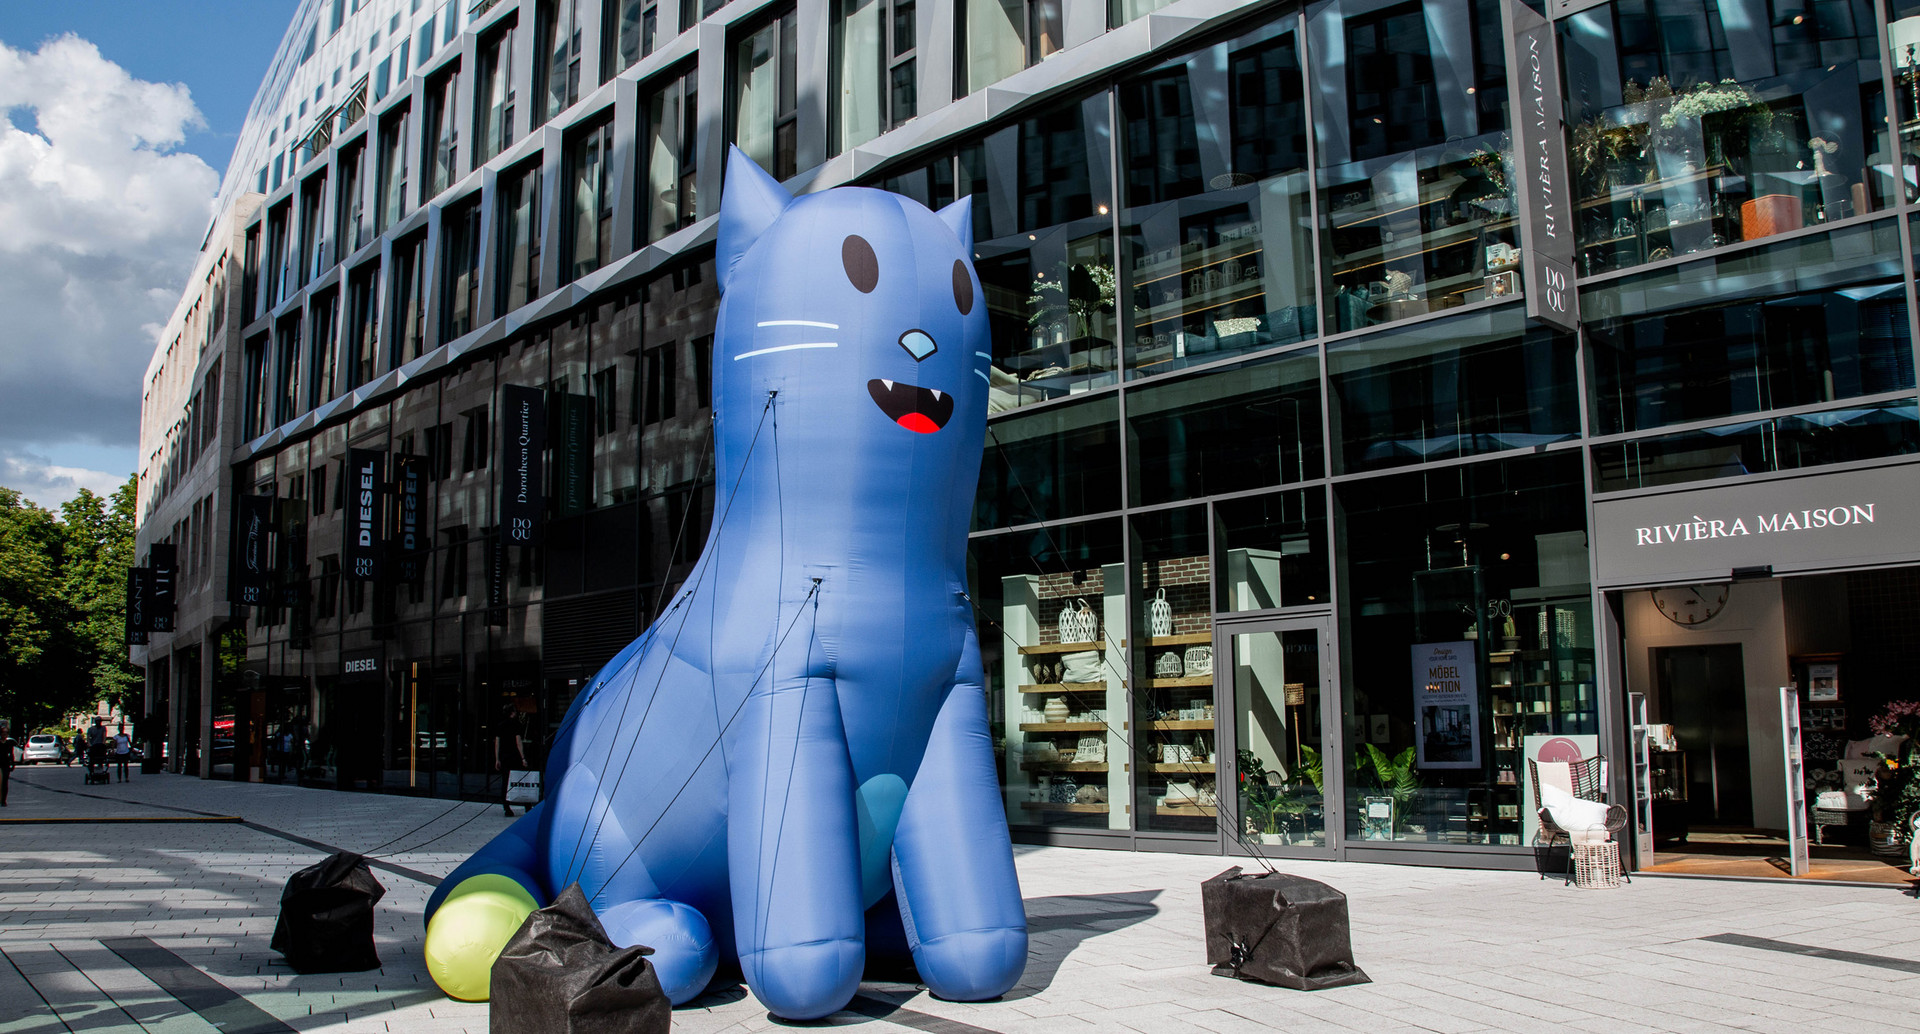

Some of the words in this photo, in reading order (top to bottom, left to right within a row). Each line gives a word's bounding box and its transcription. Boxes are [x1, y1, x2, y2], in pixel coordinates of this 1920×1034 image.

[1528, 35, 1547, 131] MAISON
[1538, 139, 1556, 239] RIVIÈRA
[1545, 266, 1565, 292] DO
[1546, 289, 1566, 312] QU
[519, 400, 530, 446] Quartier
[517, 448, 528, 504] Dorotheen
[359, 461, 374, 548] DIESEL
[512, 528, 531, 540] QU
[513, 517, 531, 529] DO
[1636, 515, 1750, 546] RIVIÈRA
[1757, 503, 1875, 534] MAISON
[355, 566, 373, 577] QU
[356, 557, 373, 567] DO
[133, 573, 143, 625] GANT
[345, 658, 377, 673] DIESEL
[1429, 665, 1460, 680] MÖBEL
[1428, 681, 1461, 693] AKTION
